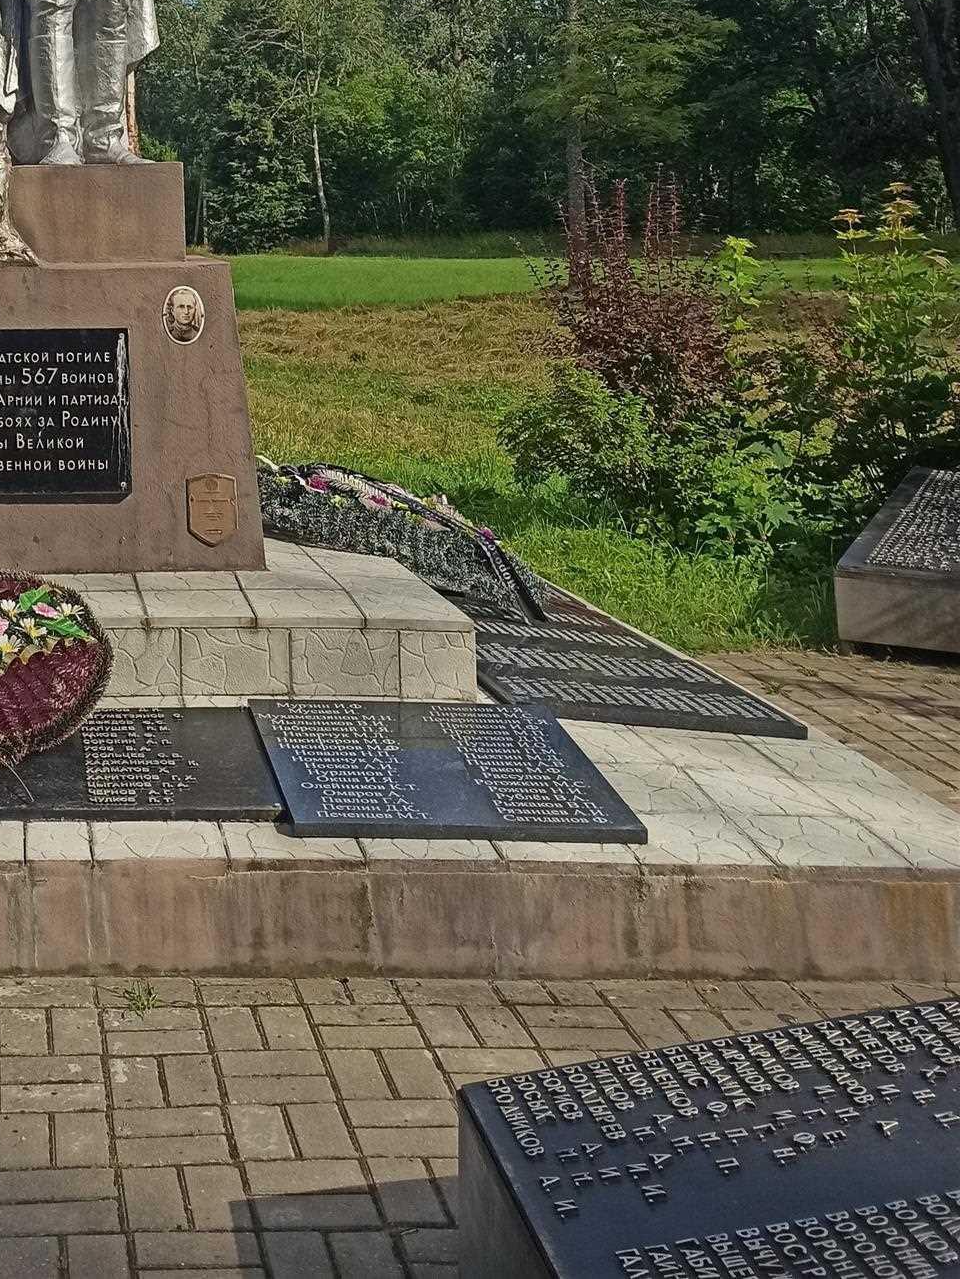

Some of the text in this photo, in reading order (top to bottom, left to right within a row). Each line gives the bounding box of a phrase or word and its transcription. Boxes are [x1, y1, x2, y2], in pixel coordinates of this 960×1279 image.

[21, 368, 58, 385] 567
[61, 371, 114, 384] ВОИНОВ
[56, 351, 111, 364] МОГИЛЕ
[37, 416, 55, 428] ЗА
[61, 410, 119, 428] РОДИНУ
[48, 395, 56, 406] И
[16, 433, 84, 450] ВЕЛИКОЙ
[58, 458, 109, 471] ВОЙНЫ
[712, 1038, 772, 1093] БАРАНОВ
[738, 1034, 800, 1092] БАРАНОВ
[763, 1030, 812, 1071] БАКУН
[814, 1020, 872, 1072] БАБАЕВ
[513, 1074, 557, 1123] БОСЫХ
[563, 1065, 628, 1140] БОГАТЫРЕВ
[587, 1060, 636, 1112] БИТКОВ
[638, 1050, 699, 1118] БЕЛЕНКОВ
[487, 1078, 545, 1156] БРОДНИКОВ
